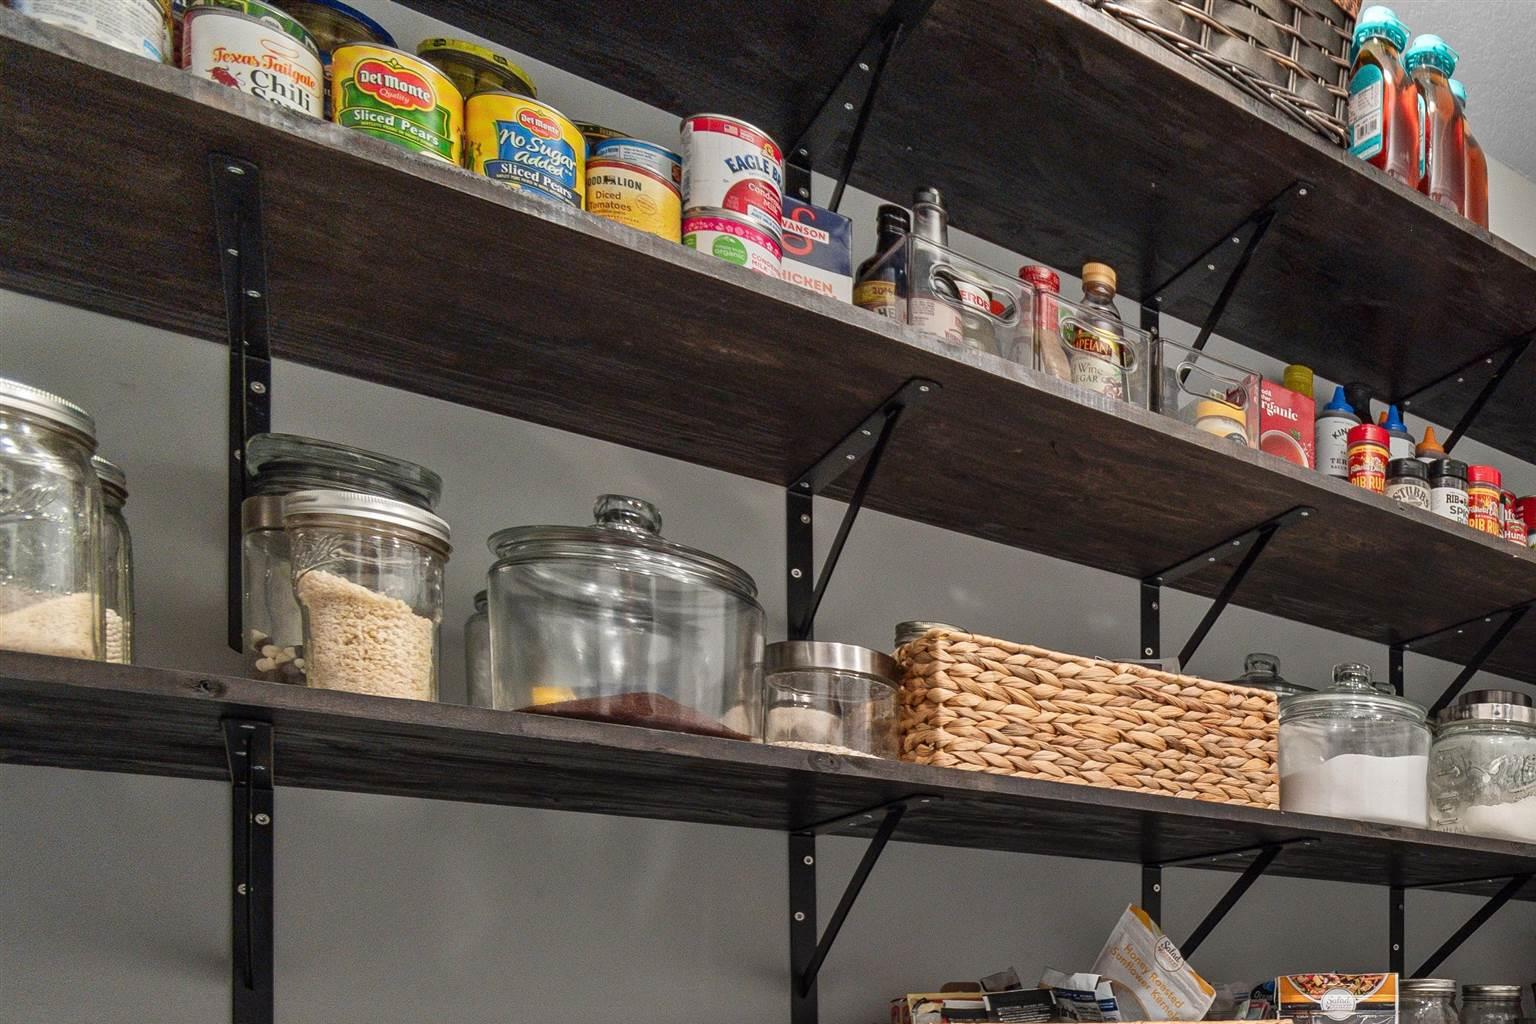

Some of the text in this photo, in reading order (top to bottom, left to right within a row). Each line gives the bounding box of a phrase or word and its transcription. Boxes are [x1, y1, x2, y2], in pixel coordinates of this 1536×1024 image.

[213, 47, 317, 89] Texas Tailgate
[250, 69, 311, 113] Chili
[360, 70, 431, 103] Del Monte
[379, 88, 410, 105] Quality
[353, 109, 395, 127] Sliced
[400, 118, 439, 147] Pears
[520, 113, 536, 125] Del
[499, 128, 526, 149] No
[525, 136, 577, 171] Sugar
[514, 150, 565, 179] Added
[723, 154, 770, 175] EAGLE
[500, 163, 540, 182] Sliced
[542, 175, 573, 200] Pears
[595, 190, 622, 200] Diced
[617, 176, 643, 192] LION
[589, 201, 632, 213] Tomatoes
[781, 219, 827, 241] WANSON
[751, 259, 768, 272] MILK
[777, 267, 834, 295] HICKEN
[1160, 939, 1182, 963] Salad
[1110, 946, 1150, 991] Sunflower
[1123, 943, 1149, 974] Honey
[1150, 972, 1185, 1010] Roasted
